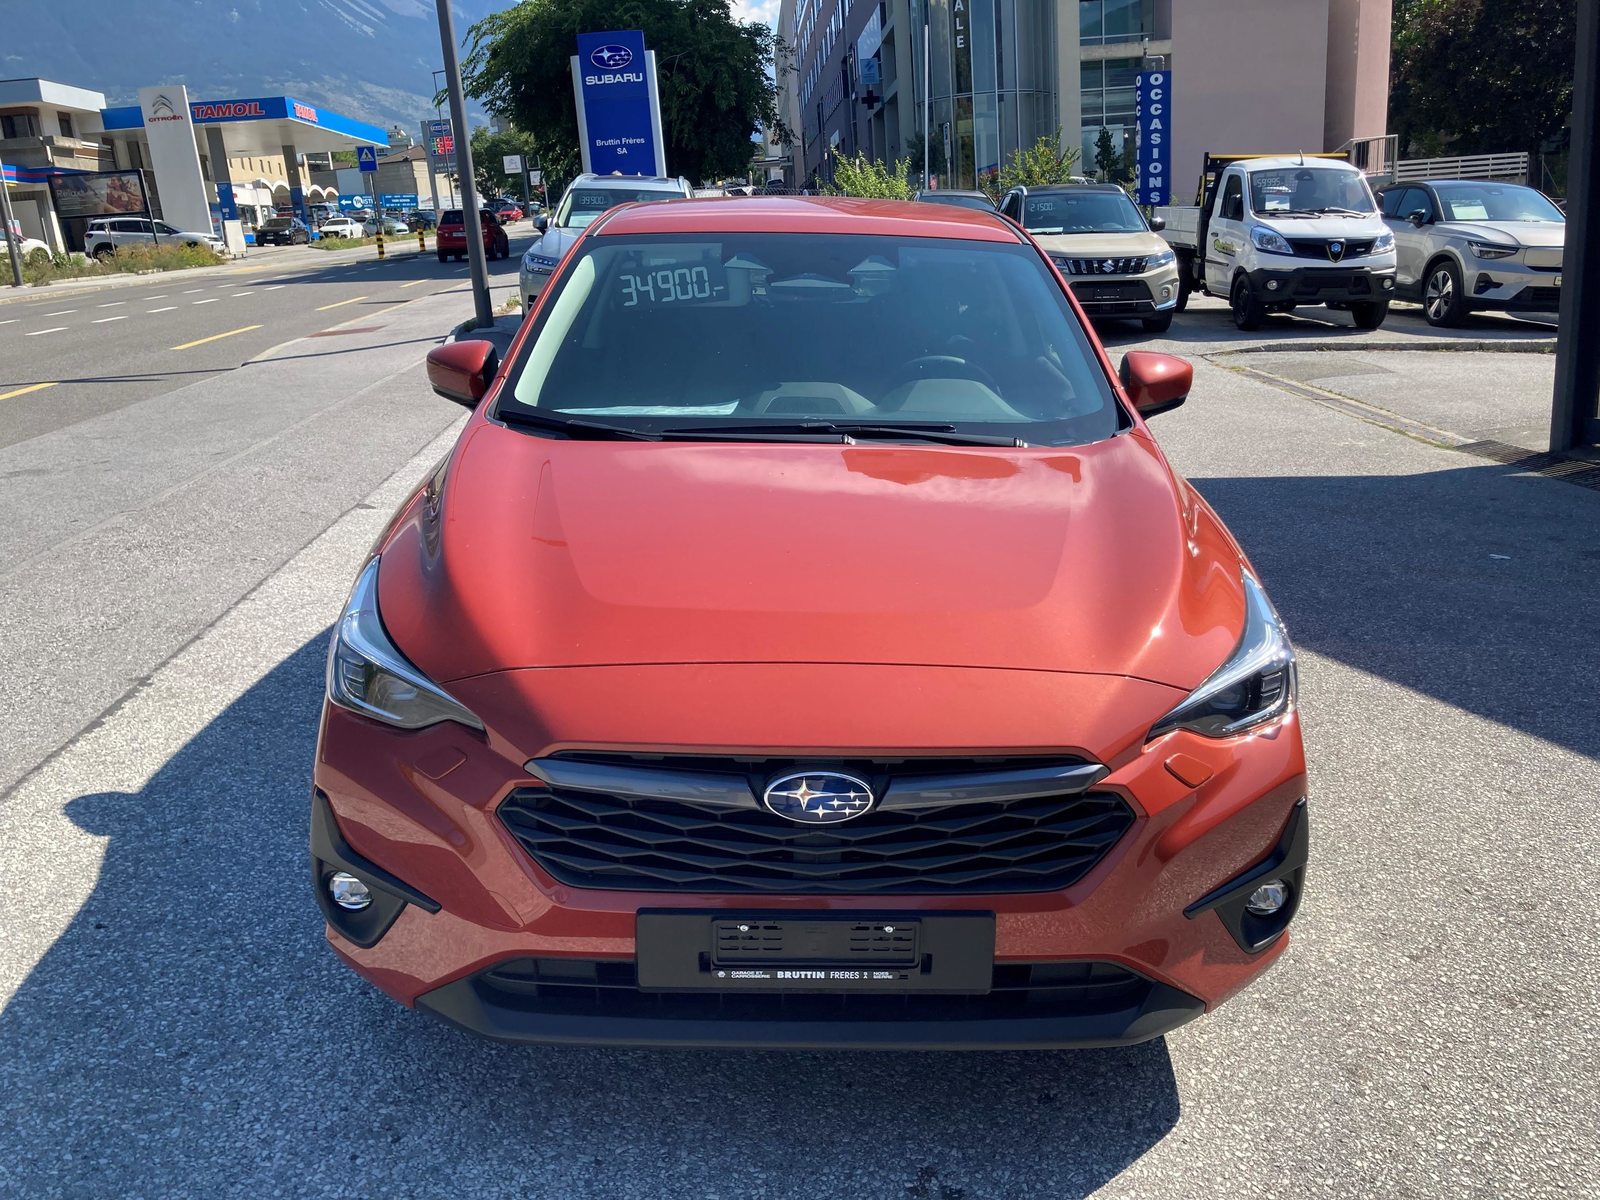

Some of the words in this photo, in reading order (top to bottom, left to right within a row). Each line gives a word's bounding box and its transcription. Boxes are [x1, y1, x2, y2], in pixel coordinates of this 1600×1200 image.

[585, 72, 643, 85] SUBARU
[192, 102, 265, 119] TAMOIL
[293, 103, 318, 122] TAMOIL
[596, 138, 620, 147] Bruttin
[621, 137, 645, 145] Frères
[1149, 73, 1164, 203] OCCASIONS
[616, 147, 628, 155] SA
[776, 971, 825, 979] BRUTTIN
